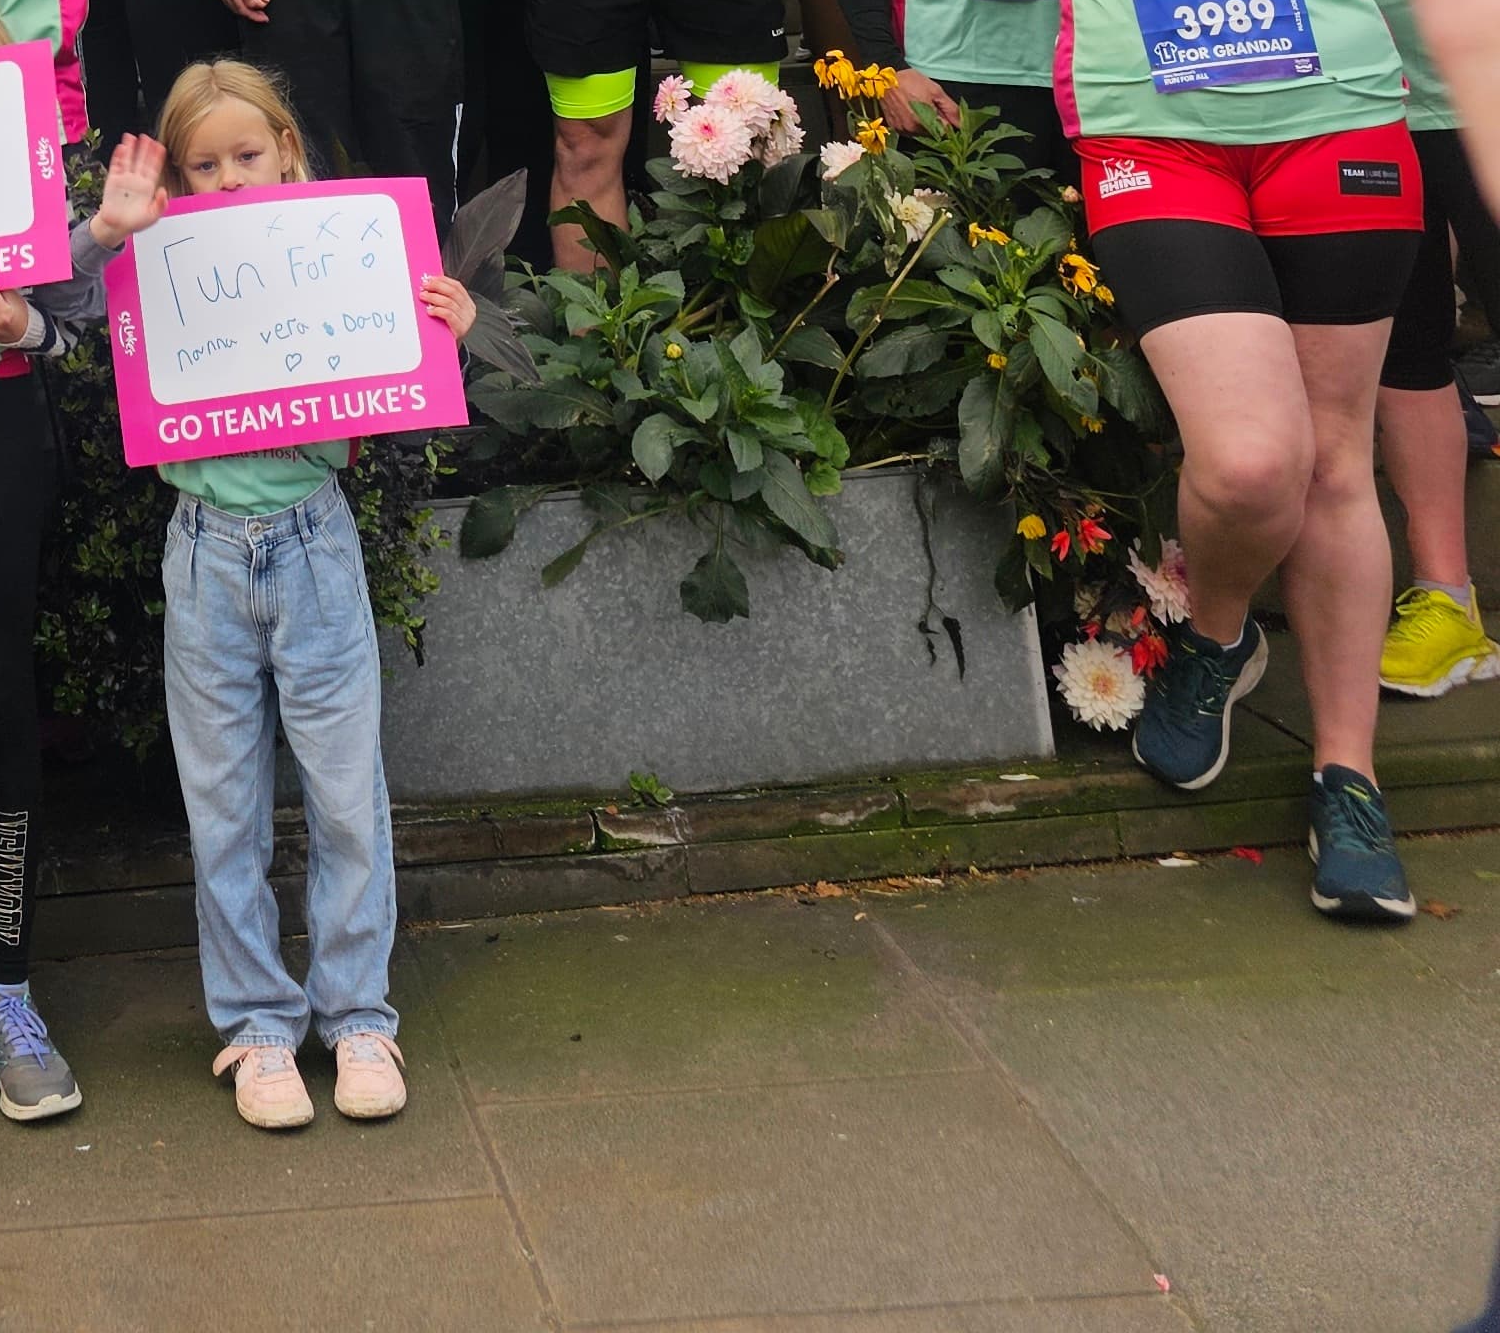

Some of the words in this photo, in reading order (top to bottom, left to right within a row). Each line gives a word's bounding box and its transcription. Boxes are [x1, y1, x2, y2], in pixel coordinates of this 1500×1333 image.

[1177, 46, 1210, 64] FOR
[1212, 37, 1293, 58] GRANDAD
[1341, 167, 1365, 178] TEAM
[1099, 174, 1152, 196] RHINO
[158, 415, 202, 443] GO
[206, 403, 284, 437] TEAM
[290, 397, 322, 426] ST
[329, 384, 427, 421] LUKE'S
